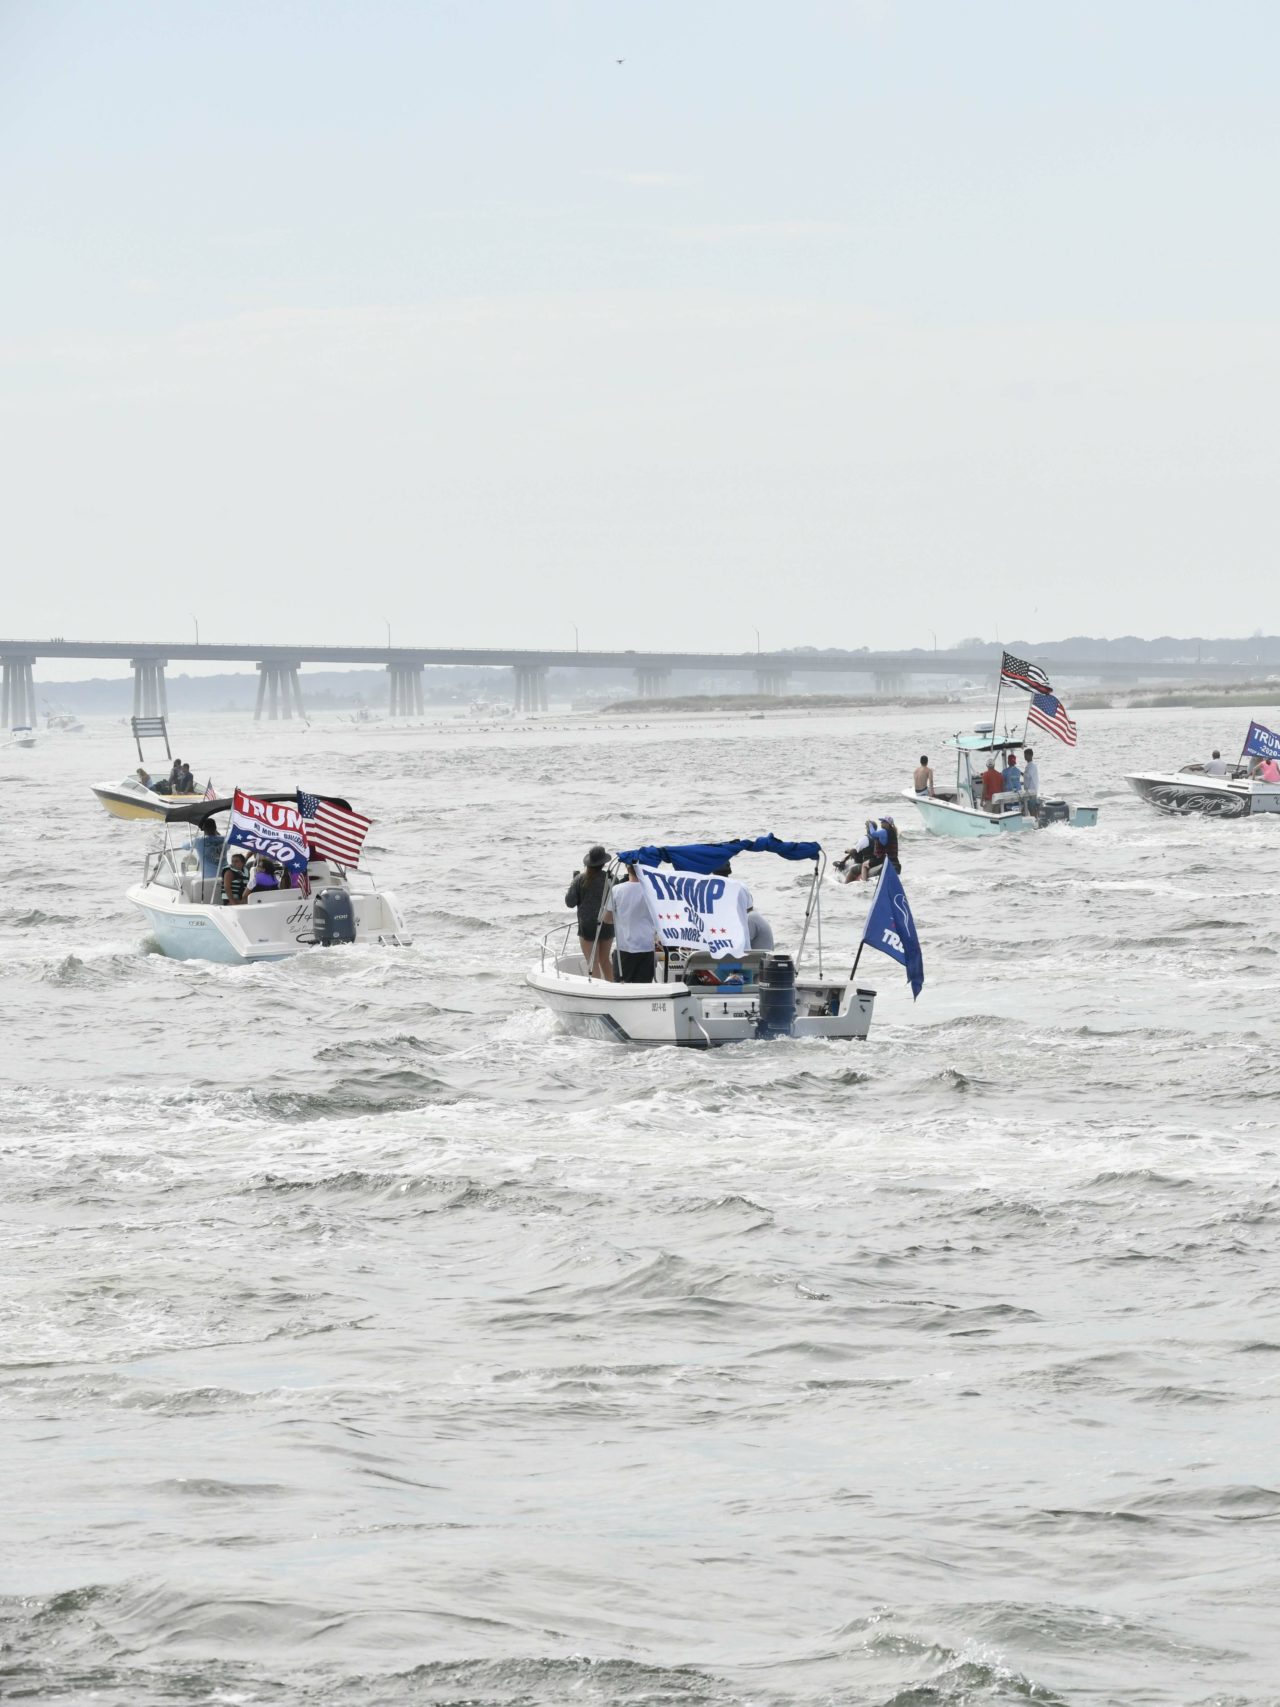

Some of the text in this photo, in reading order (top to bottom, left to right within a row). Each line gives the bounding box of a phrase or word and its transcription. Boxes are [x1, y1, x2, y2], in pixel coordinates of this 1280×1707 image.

[238, 793, 306, 835] TRUM
[242, 834, 296, 862] 2020
[662, 927, 680, 940] NO
